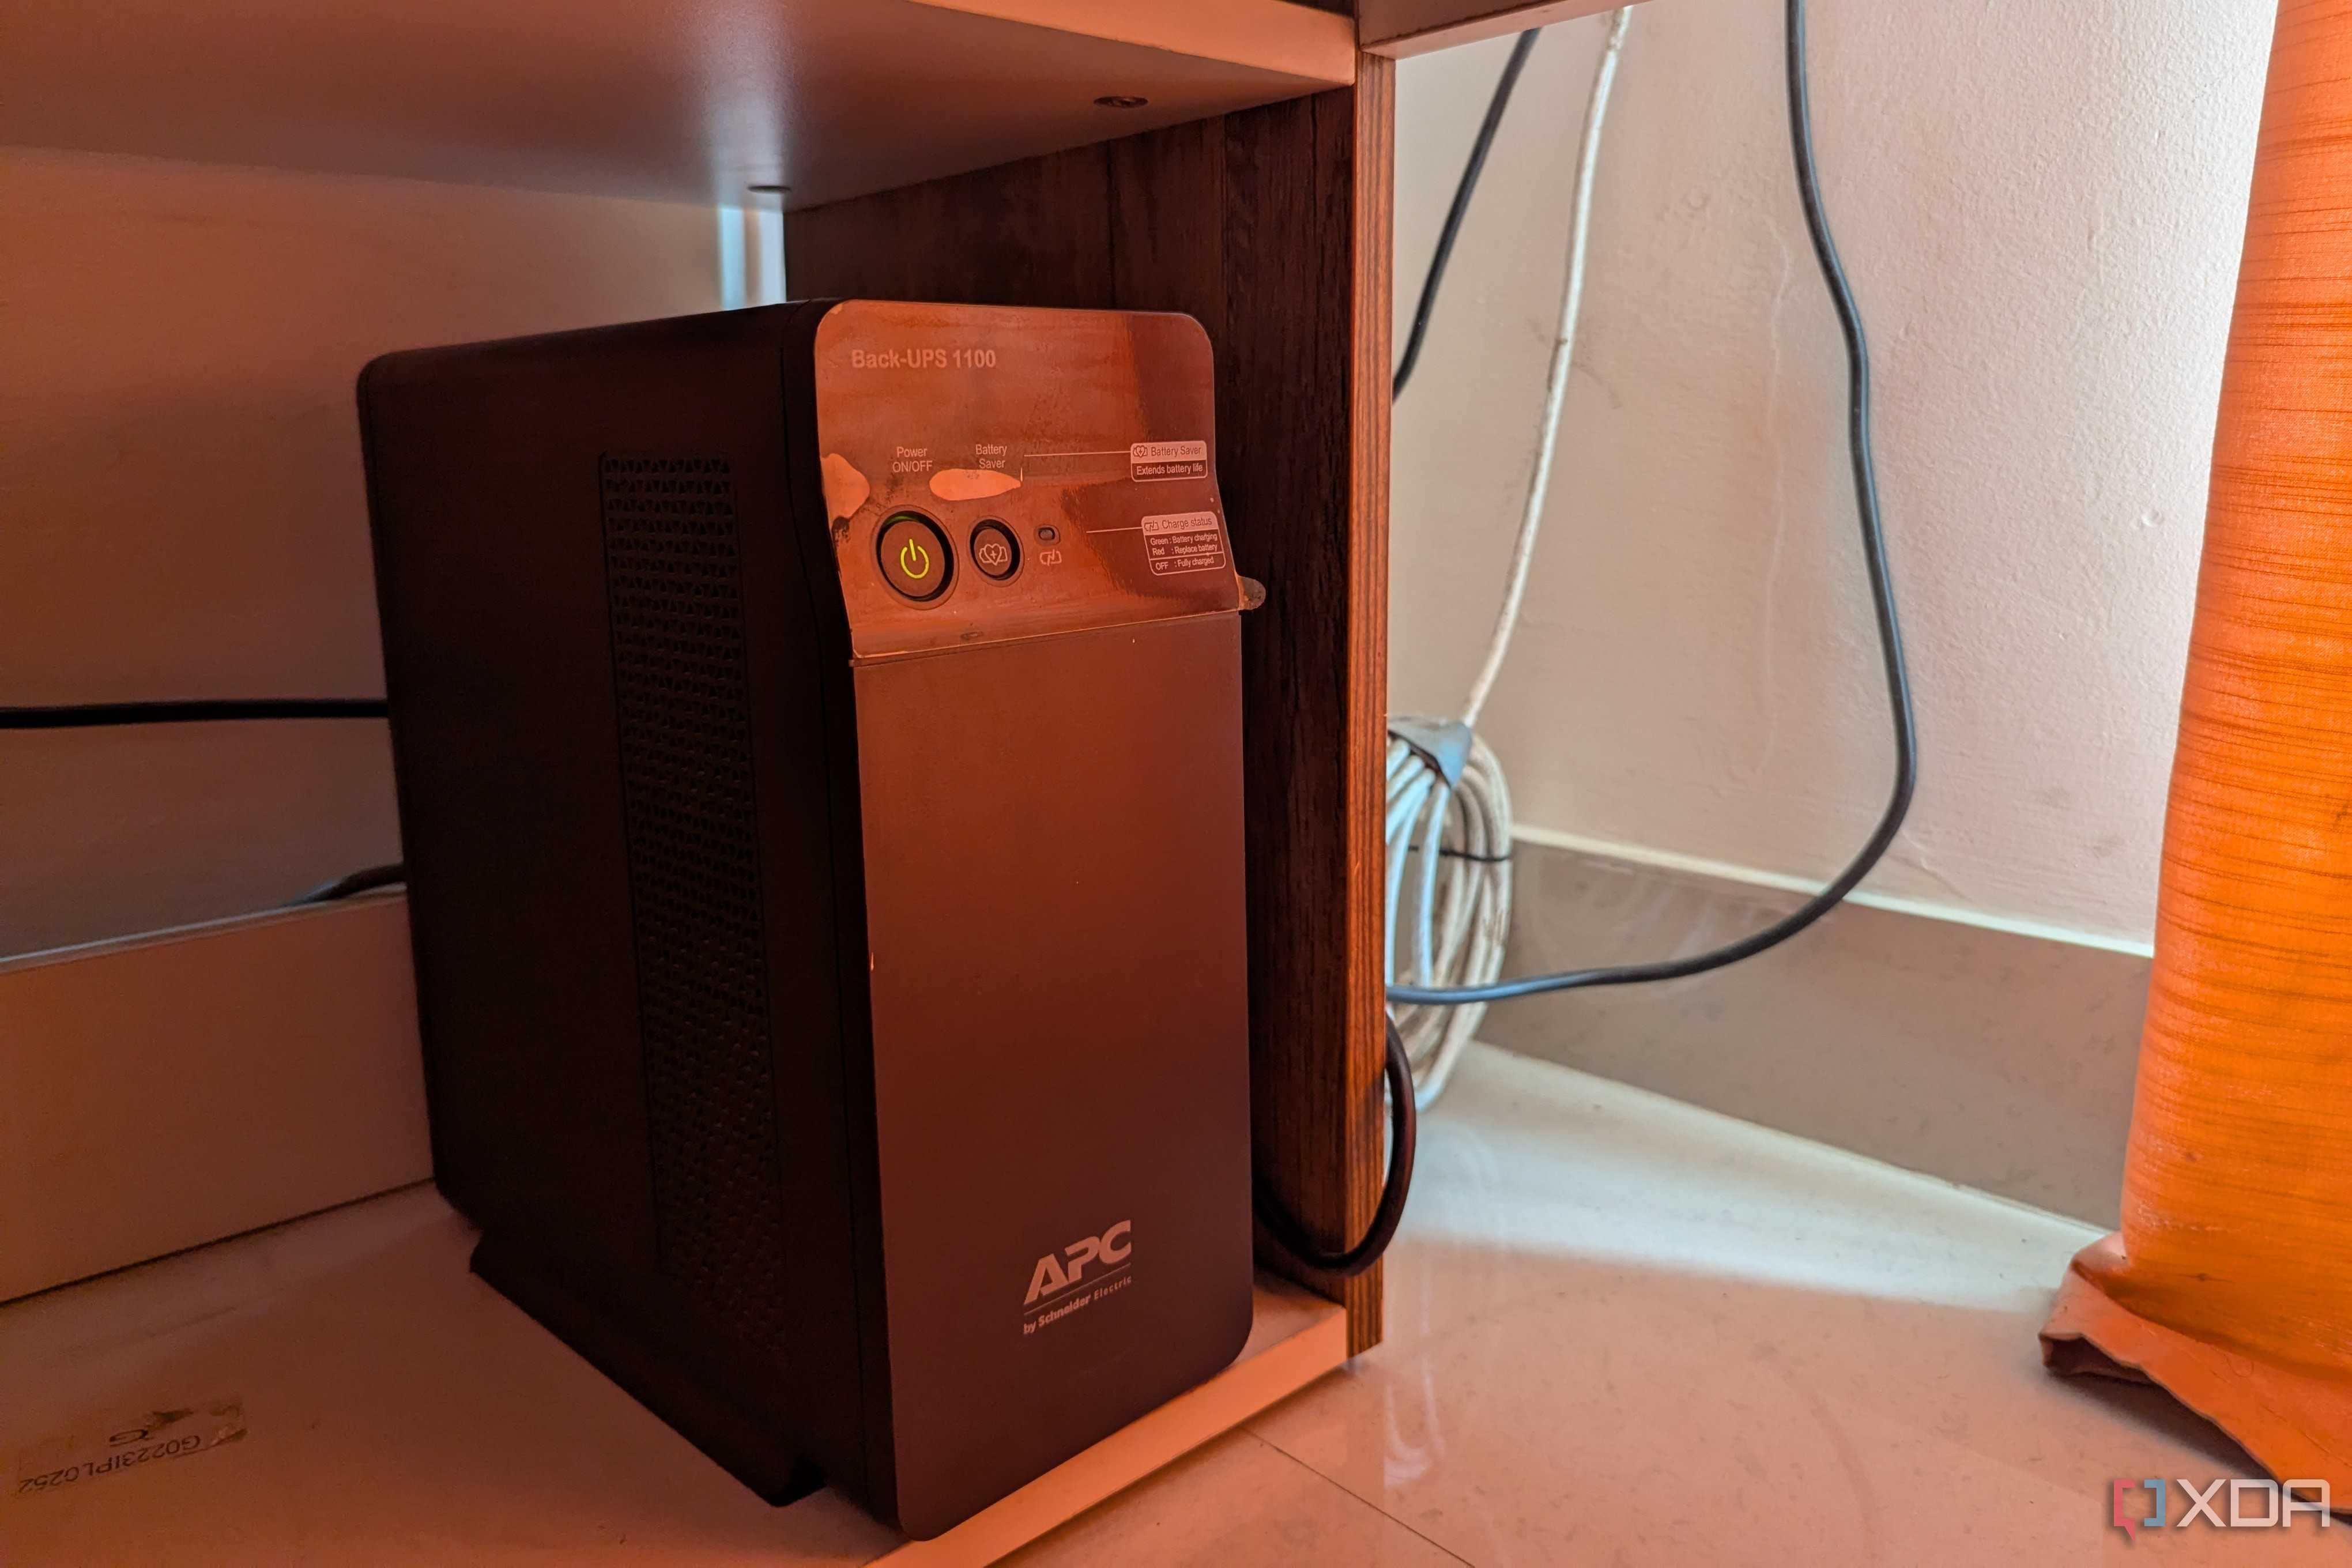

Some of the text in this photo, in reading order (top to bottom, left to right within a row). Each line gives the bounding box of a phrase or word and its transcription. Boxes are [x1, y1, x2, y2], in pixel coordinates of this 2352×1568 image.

[851, 349, 996, 368] Back-UPS 1100
[896, 447, 928, 458] Power
[975, 444, 1007, 457] Battery
[1151, 446, 1201, 457] Battery Saver
[892, 461, 933, 473] ON/OFF
[979, 458, 1005, 469] Saver
[1136, 463, 1203, 476] Extends battery life
[1162, 517, 1212, 529] Charge status
[1150, 537, 1169, 545] Green
[1172, 536, 1193, 544] Battery
[1194, 533, 1218, 542] charging
[1175, 545, 1197, 555] Replace
[1198, 543, 1218, 553] battery
[1155, 561, 1169, 571] OFF
[1177, 559, 1192, 568] Fully
[1192, 556, 1214, 567] charged
[1024, 1219, 1132, 1306] APC
[1024, 1275, 1132, 1335] by Schneider Electric
